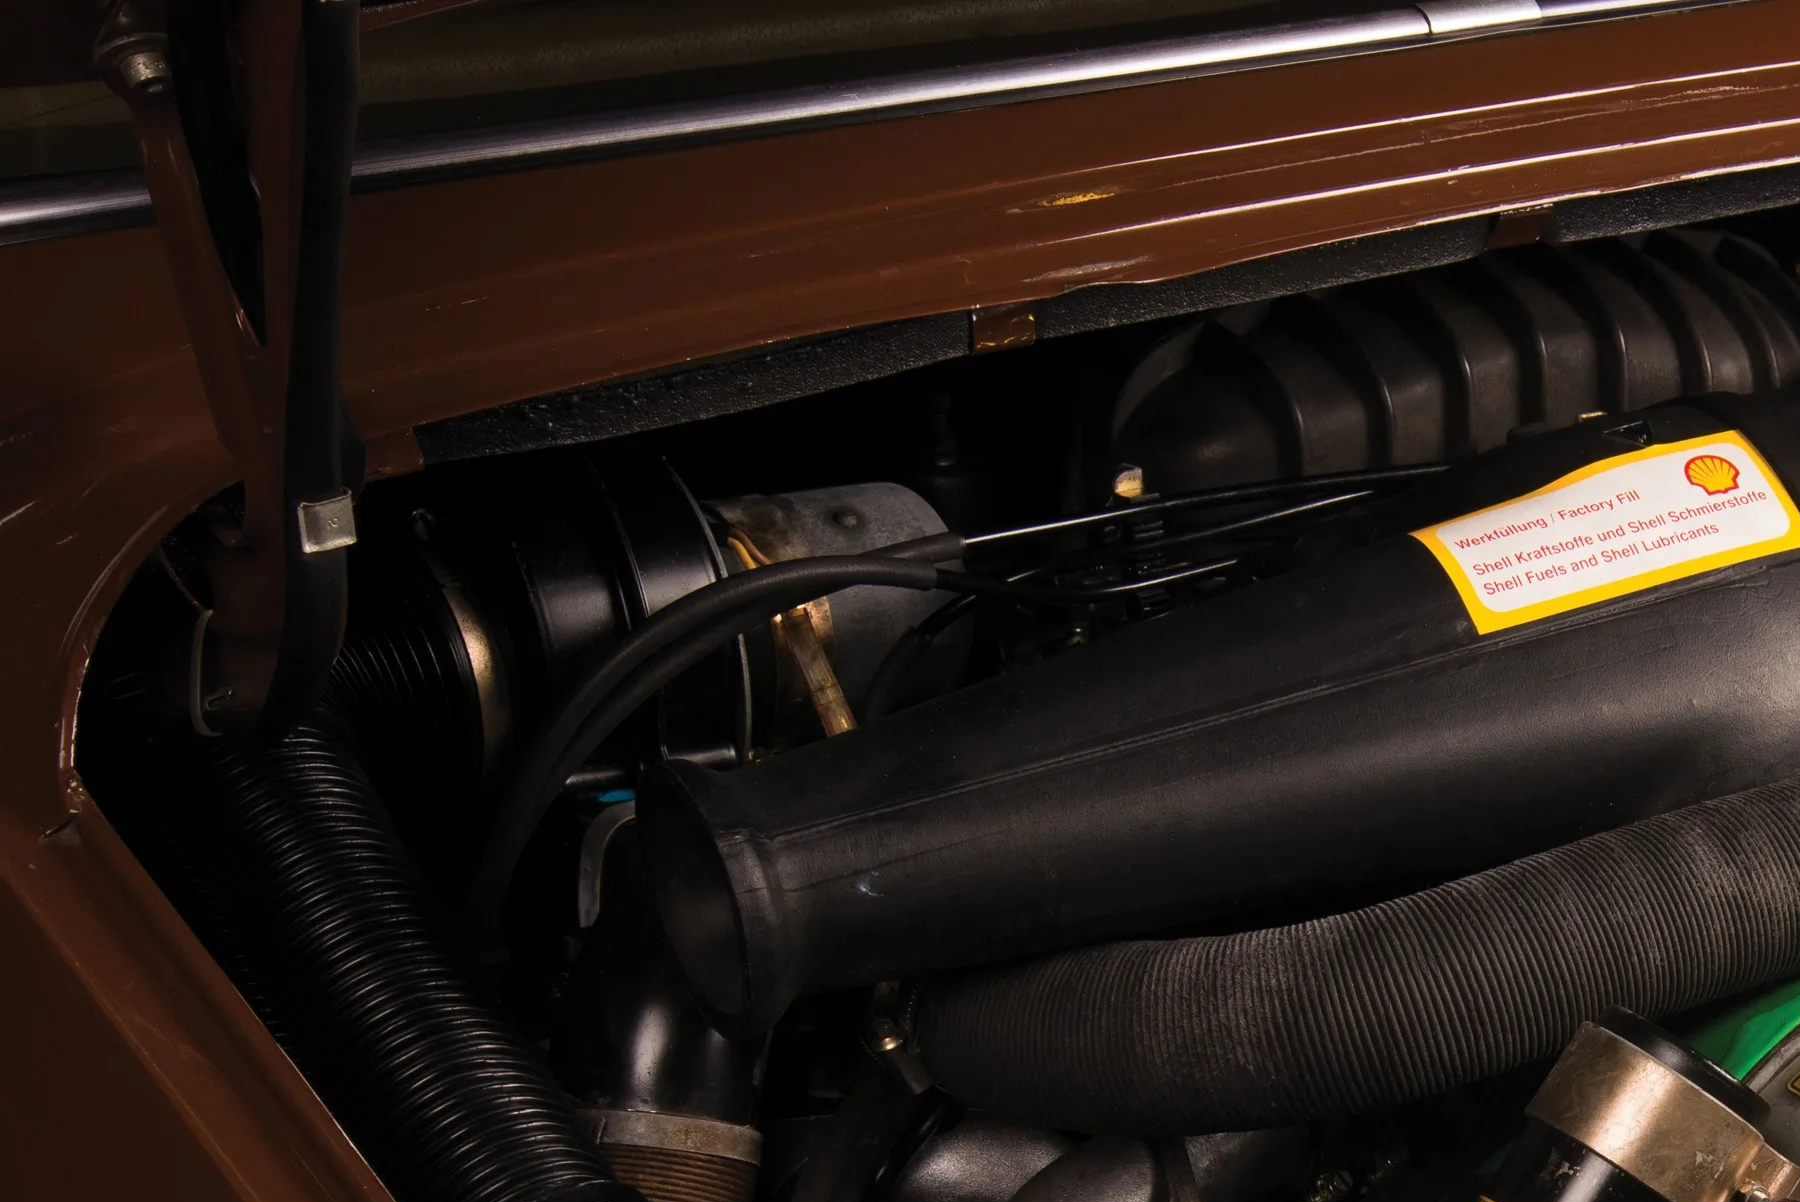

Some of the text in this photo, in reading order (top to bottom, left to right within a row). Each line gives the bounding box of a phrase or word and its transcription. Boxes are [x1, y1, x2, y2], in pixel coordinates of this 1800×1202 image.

[1454, 515, 1547, 550] Werkfüllung
[1557, 497, 1614, 522] Factory
[1616, 490, 1640, 511] Fill
[1473, 490, 1767, 577] Shell Kraftstoffe und Shell Schmierstoffe
[1484, 523, 1719, 596] Shell Fuels and Shell Lubricants
